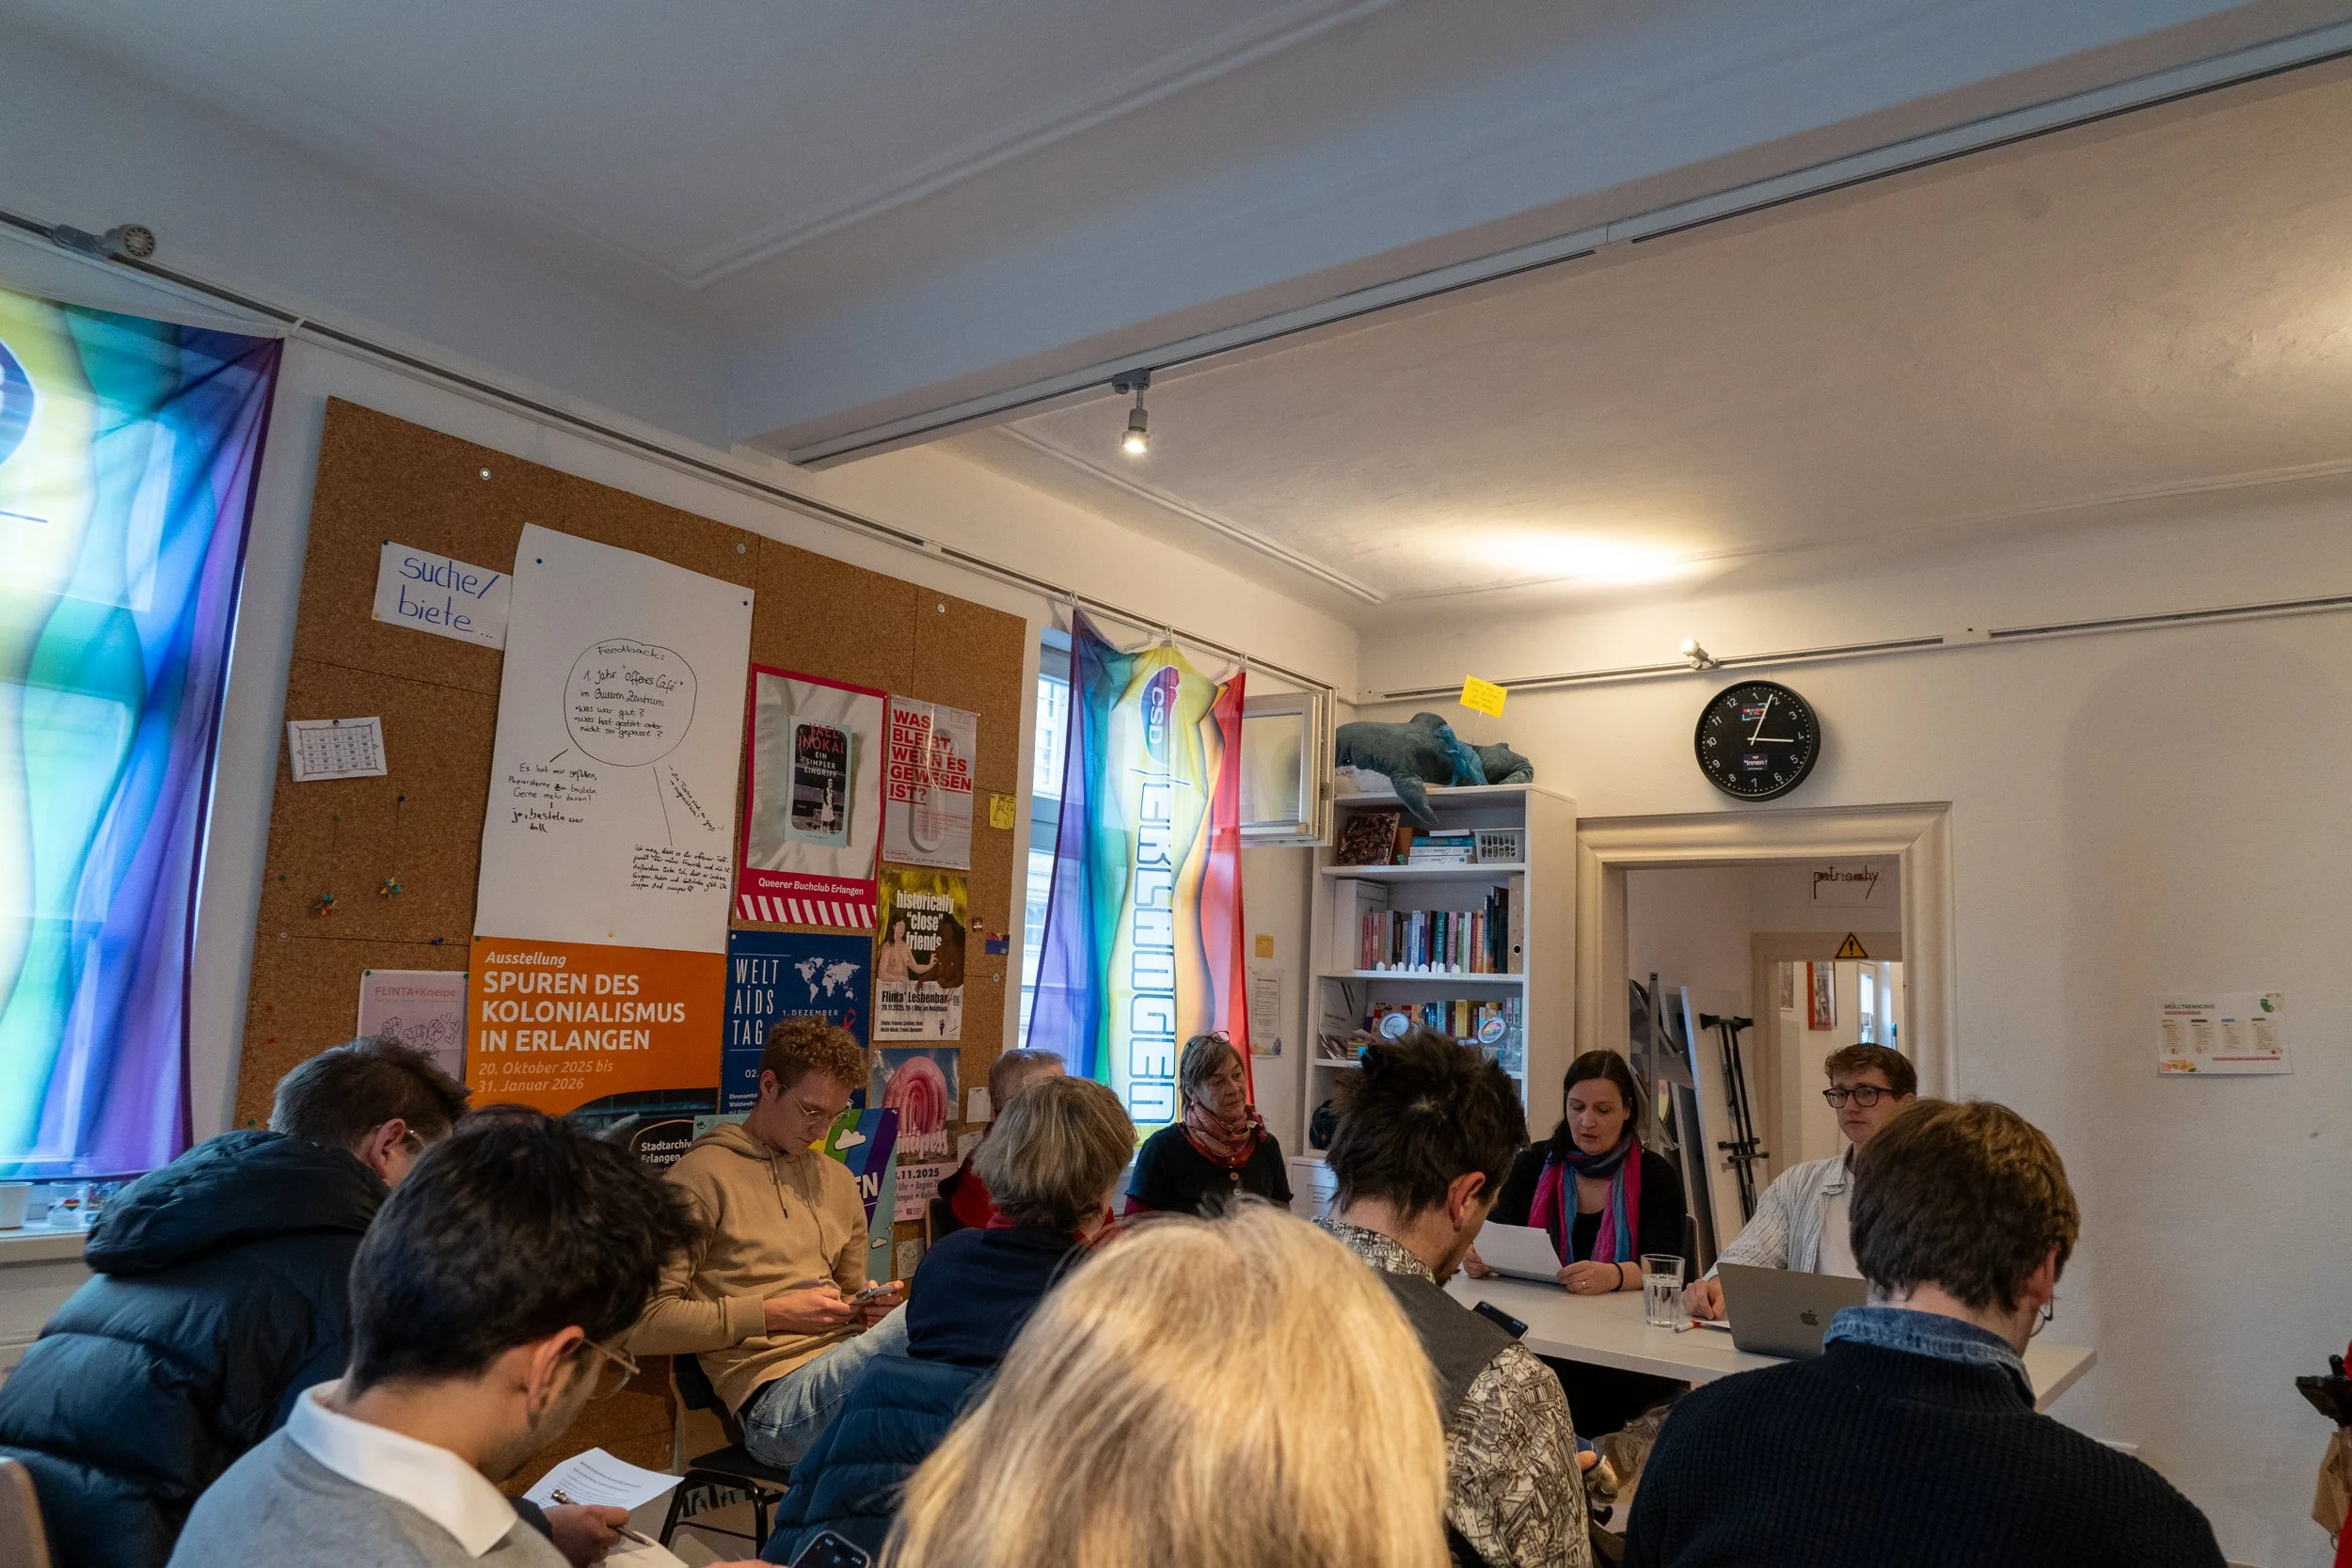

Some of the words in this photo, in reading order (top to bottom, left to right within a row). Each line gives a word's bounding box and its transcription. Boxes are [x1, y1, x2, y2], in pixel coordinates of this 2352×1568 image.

[399, 557, 500, 599] suche/
[596, 645, 664, 660] Feedback:
[583, 670, 592, 682] 1.
[595, 669, 617, 685] Jahr
[626, 690, 664, 707] Zentrum
[1726, 698, 1739, 708] 12
[1772, 697, 1781, 705] 2
[893, 709, 931, 730] WAS
[1149, 687, 1165, 744] CSD
[1712, 716, 1723, 726] 11
[1788, 711, 1797, 720] 3
[809, 721, 839, 739] YAEL
[799, 736, 844, 754] INOKAI
[1707, 736, 1717, 747] 10
[805, 758, 836, 769] SIMPLER
[892, 747, 942, 768] WENN
[946, 757, 967, 773] ES
[1712, 759, 1721, 768] 9
[1790, 754, 1799, 764] 5
[519, 763, 530, 772] Es
[536, 764, 548, 772] hat
[804, 767, 837, 778] EINGRIFF
[508, 775, 550, 788] Papiersterne
[889, 766, 972, 791] GEWESEN
[1728, 773, 1737, 783] 8
[1751, 778, 1757, 788] 7
[1774, 772, 1783, 782] 6
[514, 787, 537, 798] Gerne
[889, 784, 928, 800] IST?
[758, 878, 793, 890] Queerer
[794, 880, 831, 893] Buchclub
[831, 883, 864, 895] Erlangen
[897, 889, 955, 914] historically
[906, 931, 942, 951] friends
[485, 951, 567, 968] Ausstellung
[1128, 782, 1176, 1125] ERLANGEN
[736, 958, 779, 985] WELT
[483, 971, 587, 994] SPUREN
[594, 974, 640, 995] DES
[908, 991, 947, 1004] Lesbenbar
[482, 1000, 686, 1023] KOLONIALISMUS
[480, 1030, 507, 1052] IN
[516, 1028, 650, 1052] ERLANGEN
[733, 1020, 763, 1046] TAG
[478, 1062, 498, 1076] 20.
[502, 1060, 559, 1075] Oktober
[561, 1060, 593, 1074] 2025
[596, 1059, 613, 1072] bis
[744, 1069, 759, 1078] 02.
[478, 1080, 497, 1093] 31.
[501, 1078, 549, 1092] Januar
[551, 1078, 584, 1090] 2026
[641, 1138, 692, 1152] Stadtarchiv
[641, 1152, 680, 1165] Erlangen
[896, 1168, 939, 1180] .11.2025
[898, 1180, 908, 1191] Uhr
